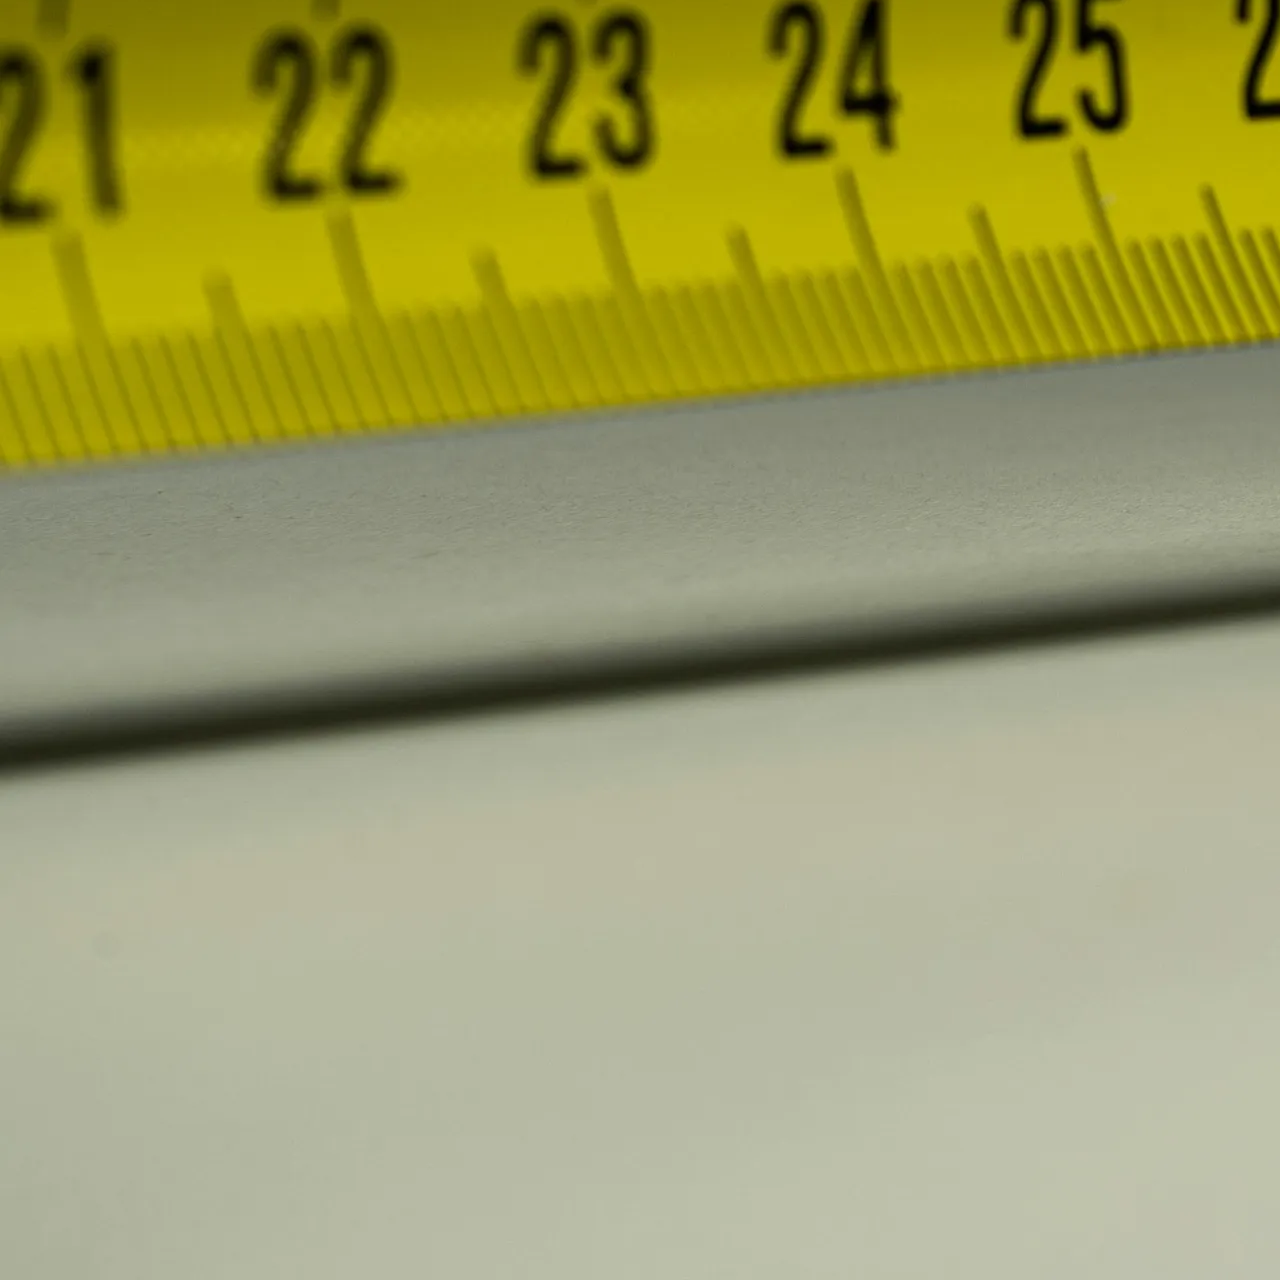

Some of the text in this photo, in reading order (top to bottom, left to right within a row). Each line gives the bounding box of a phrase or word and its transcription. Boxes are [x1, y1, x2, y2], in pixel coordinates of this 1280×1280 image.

[0, 42, 122, 226] 21
[250, 22, 404, 206] 22
[517, 8, 656, 182] 23
